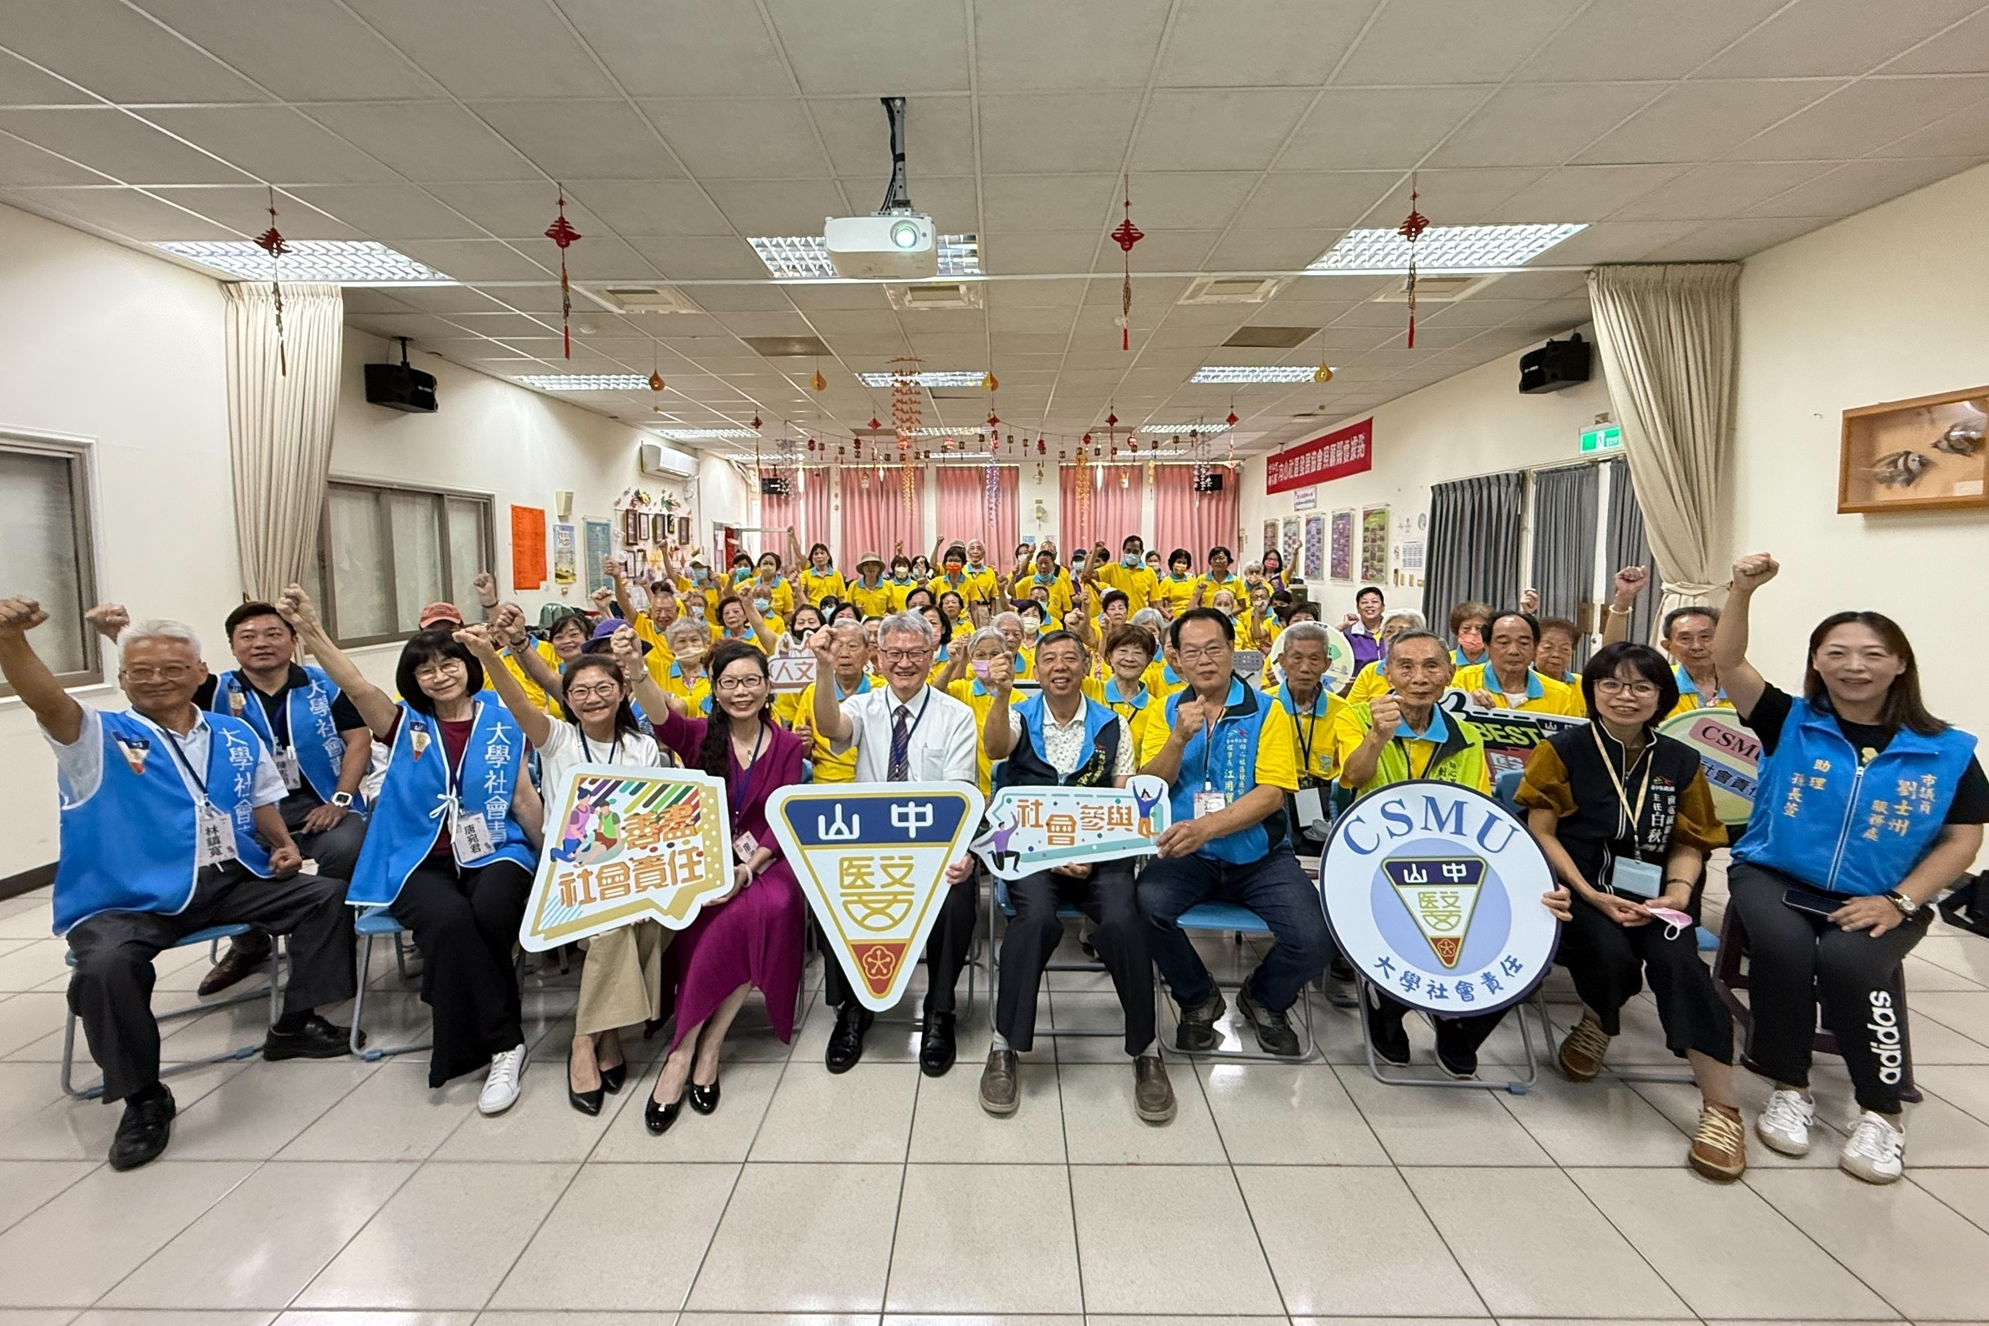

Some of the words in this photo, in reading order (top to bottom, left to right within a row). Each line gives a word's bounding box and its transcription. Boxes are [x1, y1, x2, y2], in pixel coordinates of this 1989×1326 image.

[775, 661, 814, 681] 人文
[1473, 722, 1540, 746] BEST
[1701, 725, 1760, 762] CSM
[218, 727, 254, 832] 大學社會
[1809, 759, 1832, 791] 助理
[1918, 773, 1938, 815] 市議員
[1017, 799, 1134, 846] 社會參與
[1343, 795, 1520, 856] CSMU
[1886, 779, 1918, 837] 劉士州
[558, 846, 704, 908] 社會責任
[1374, 955, 1523, 1002] 大學社會責任
[1866, 990, 1903, 1085] adidas
